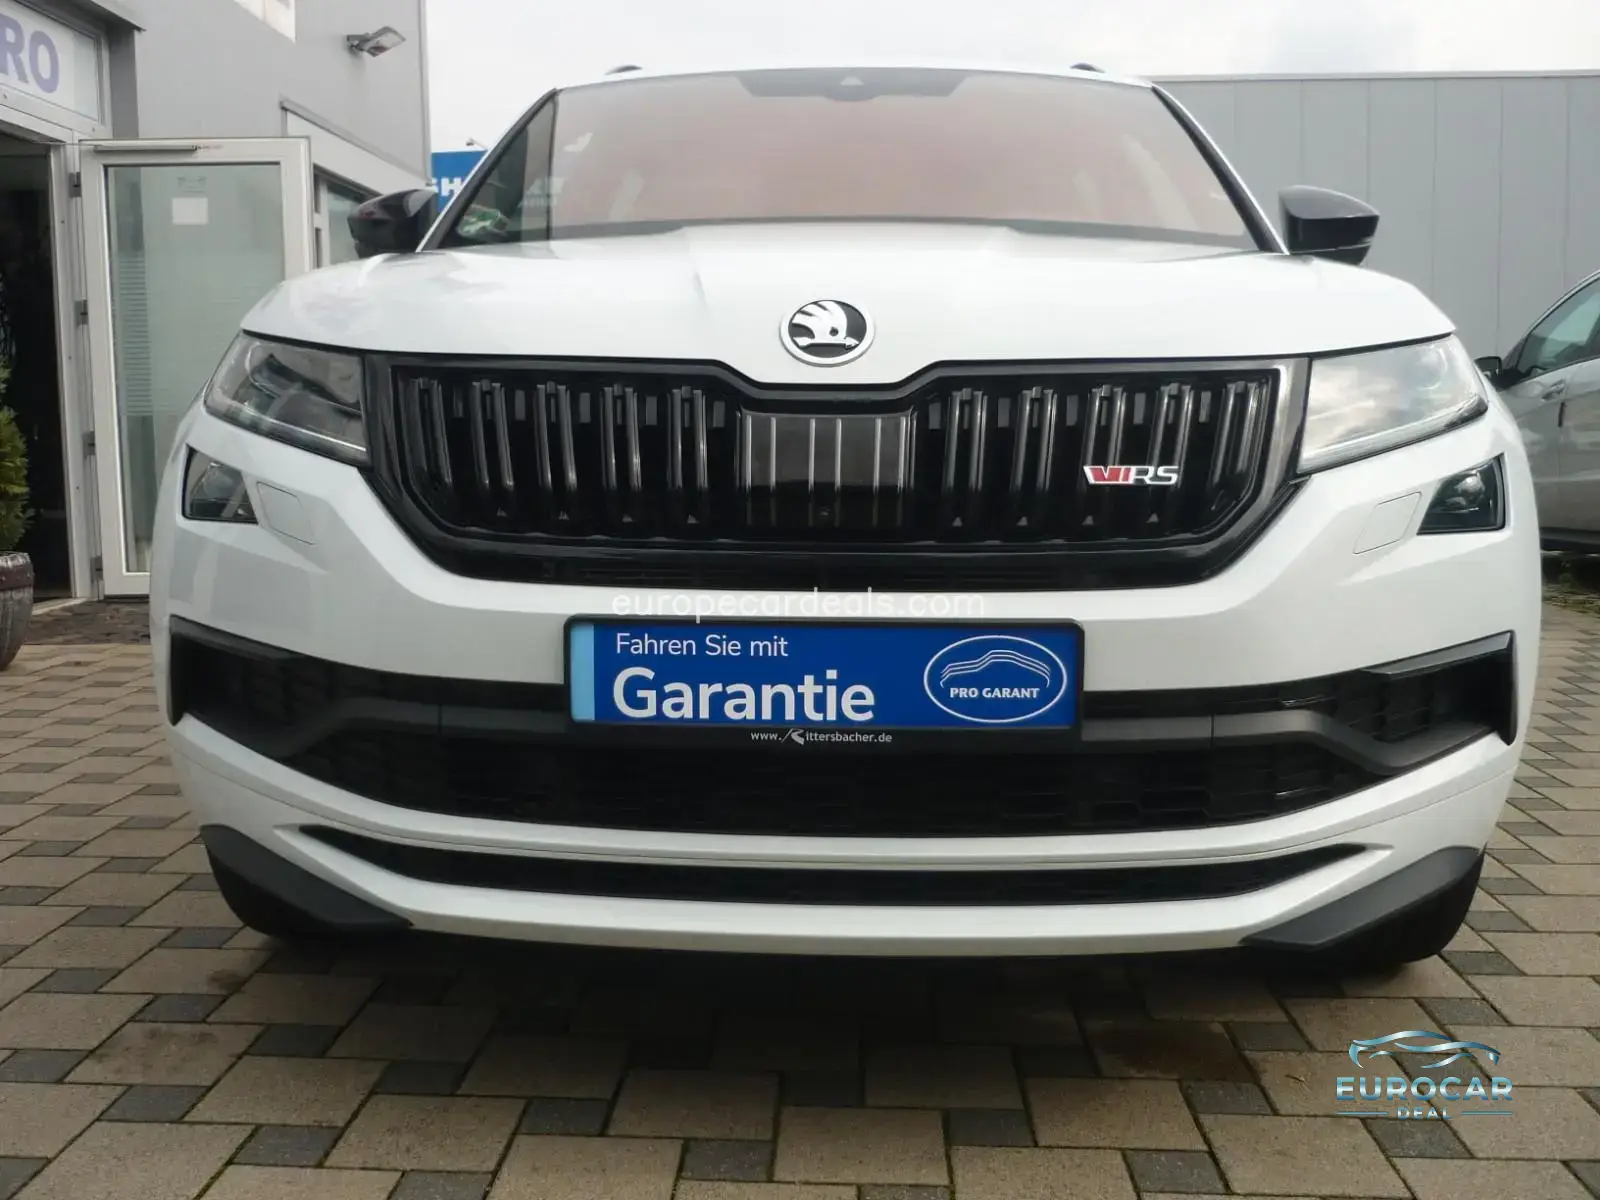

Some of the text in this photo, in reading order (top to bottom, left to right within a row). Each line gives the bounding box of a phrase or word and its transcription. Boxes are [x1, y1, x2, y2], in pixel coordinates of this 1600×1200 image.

[616, 632, 789, 657] Fahren Sie mit
[613, 666, 876, 721] Garantie
[949, 687, 1040, 698] PRO GARANT
